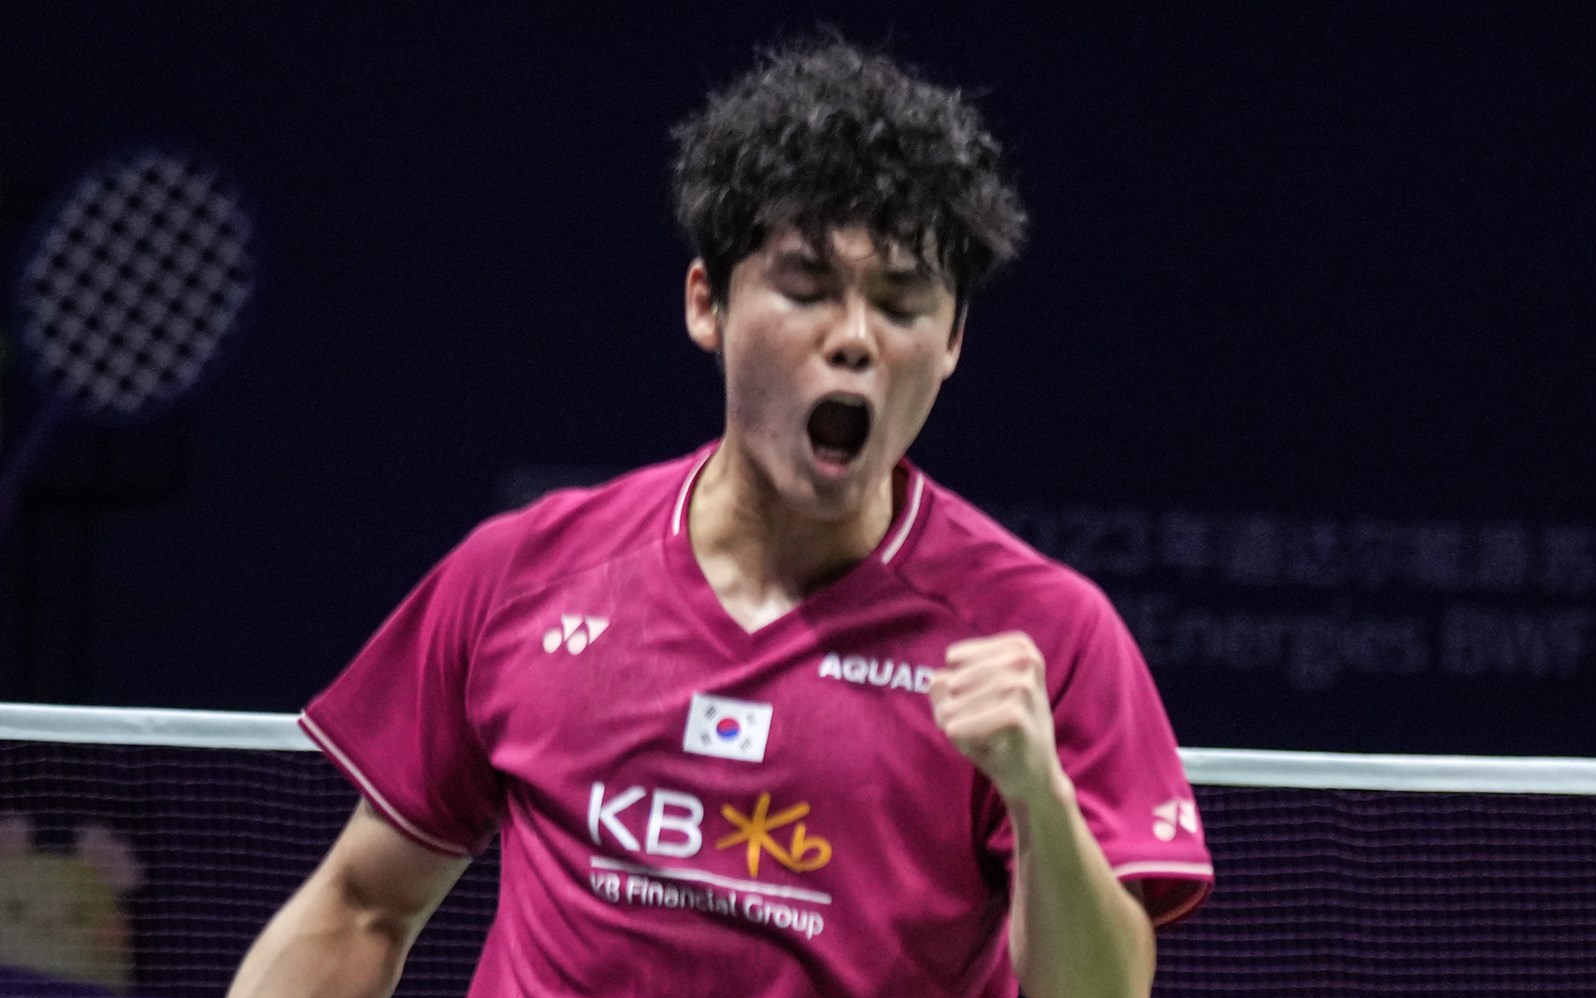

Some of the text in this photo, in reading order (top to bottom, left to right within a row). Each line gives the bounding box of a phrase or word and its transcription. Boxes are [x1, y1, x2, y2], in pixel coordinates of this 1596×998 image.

[818, 651, 938, 694] AQUAD
[1116, 588, 1430, 692] Energies
[1440, 602, 1596, 678] BWF
[588, 782, 704, 858] KB
[626, 878, 737, 916] Financial
[743, 895, 824, 940] Group
